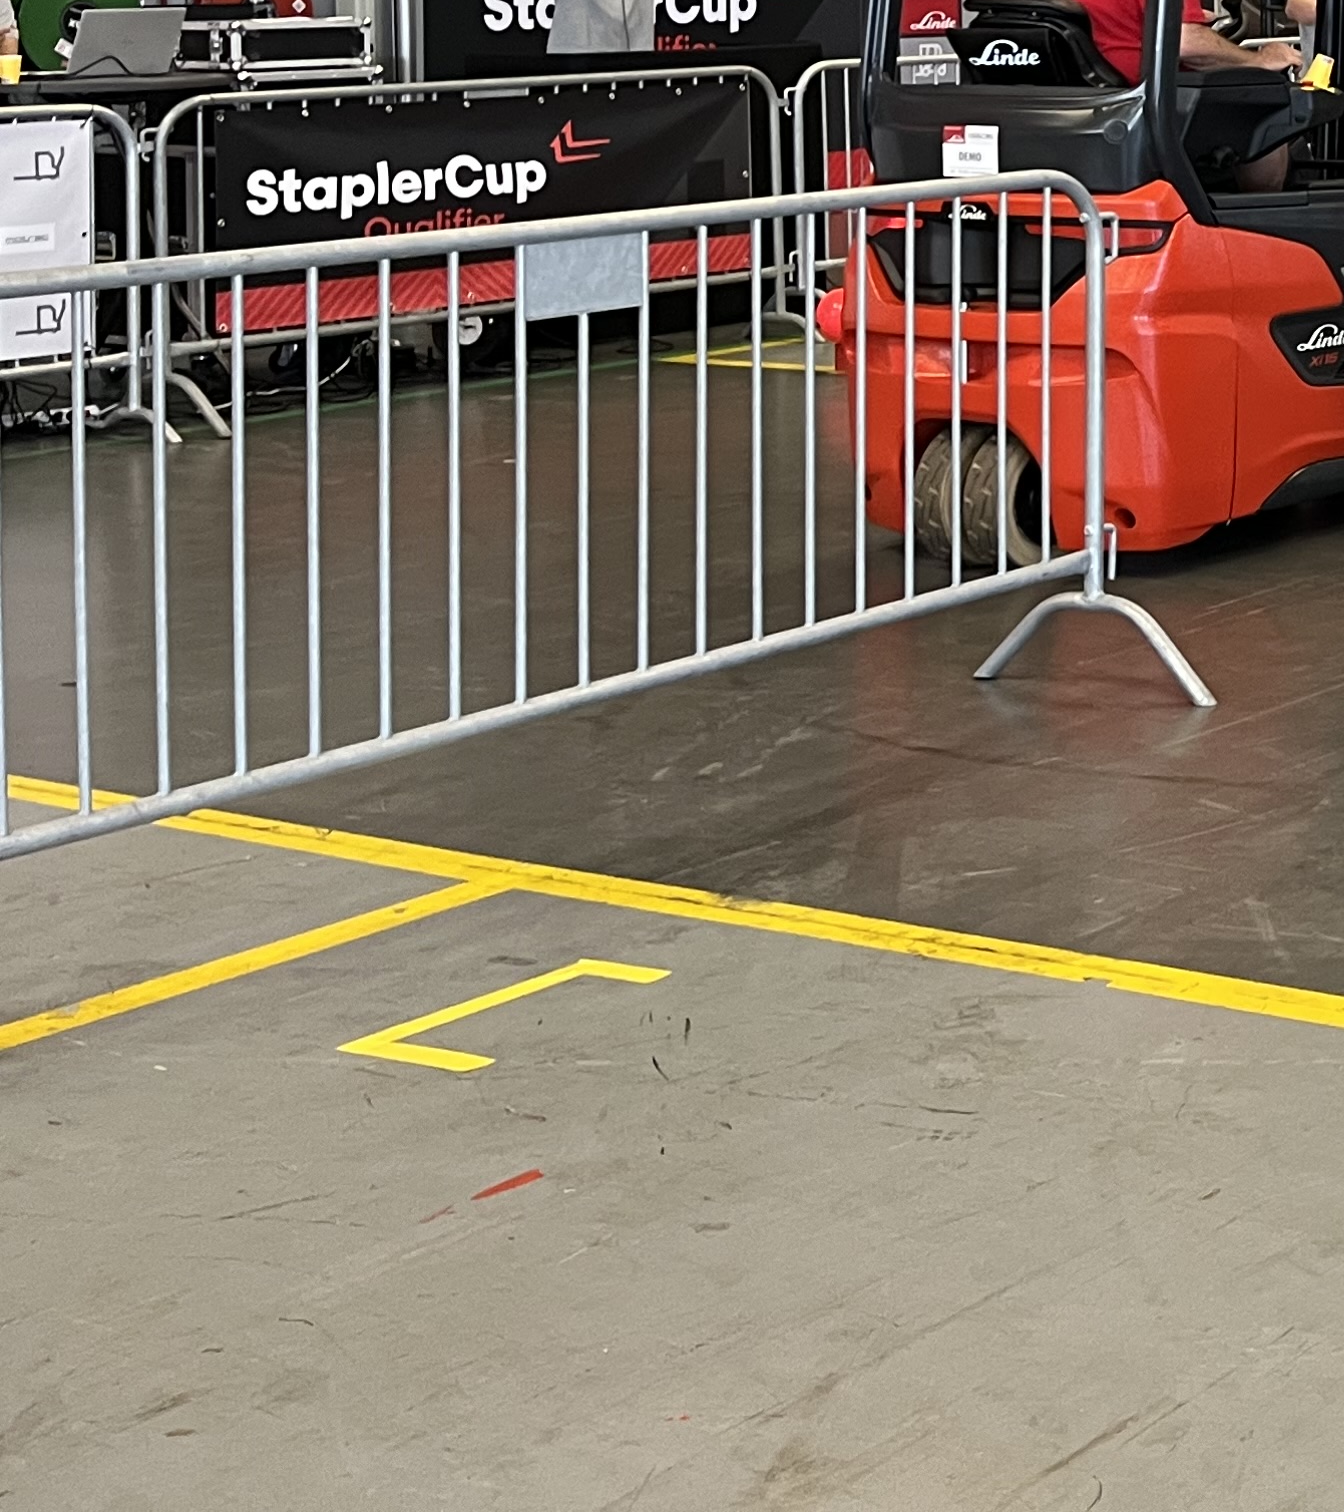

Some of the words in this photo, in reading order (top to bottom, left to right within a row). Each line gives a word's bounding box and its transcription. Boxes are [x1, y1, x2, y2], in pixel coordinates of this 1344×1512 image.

[909, 10, 957, 30] Linde
[968, 39, 1041, 66] Linde
[958, 151, 983, 162] DEMO
[246, 154, 547, 220] StaplerCup
